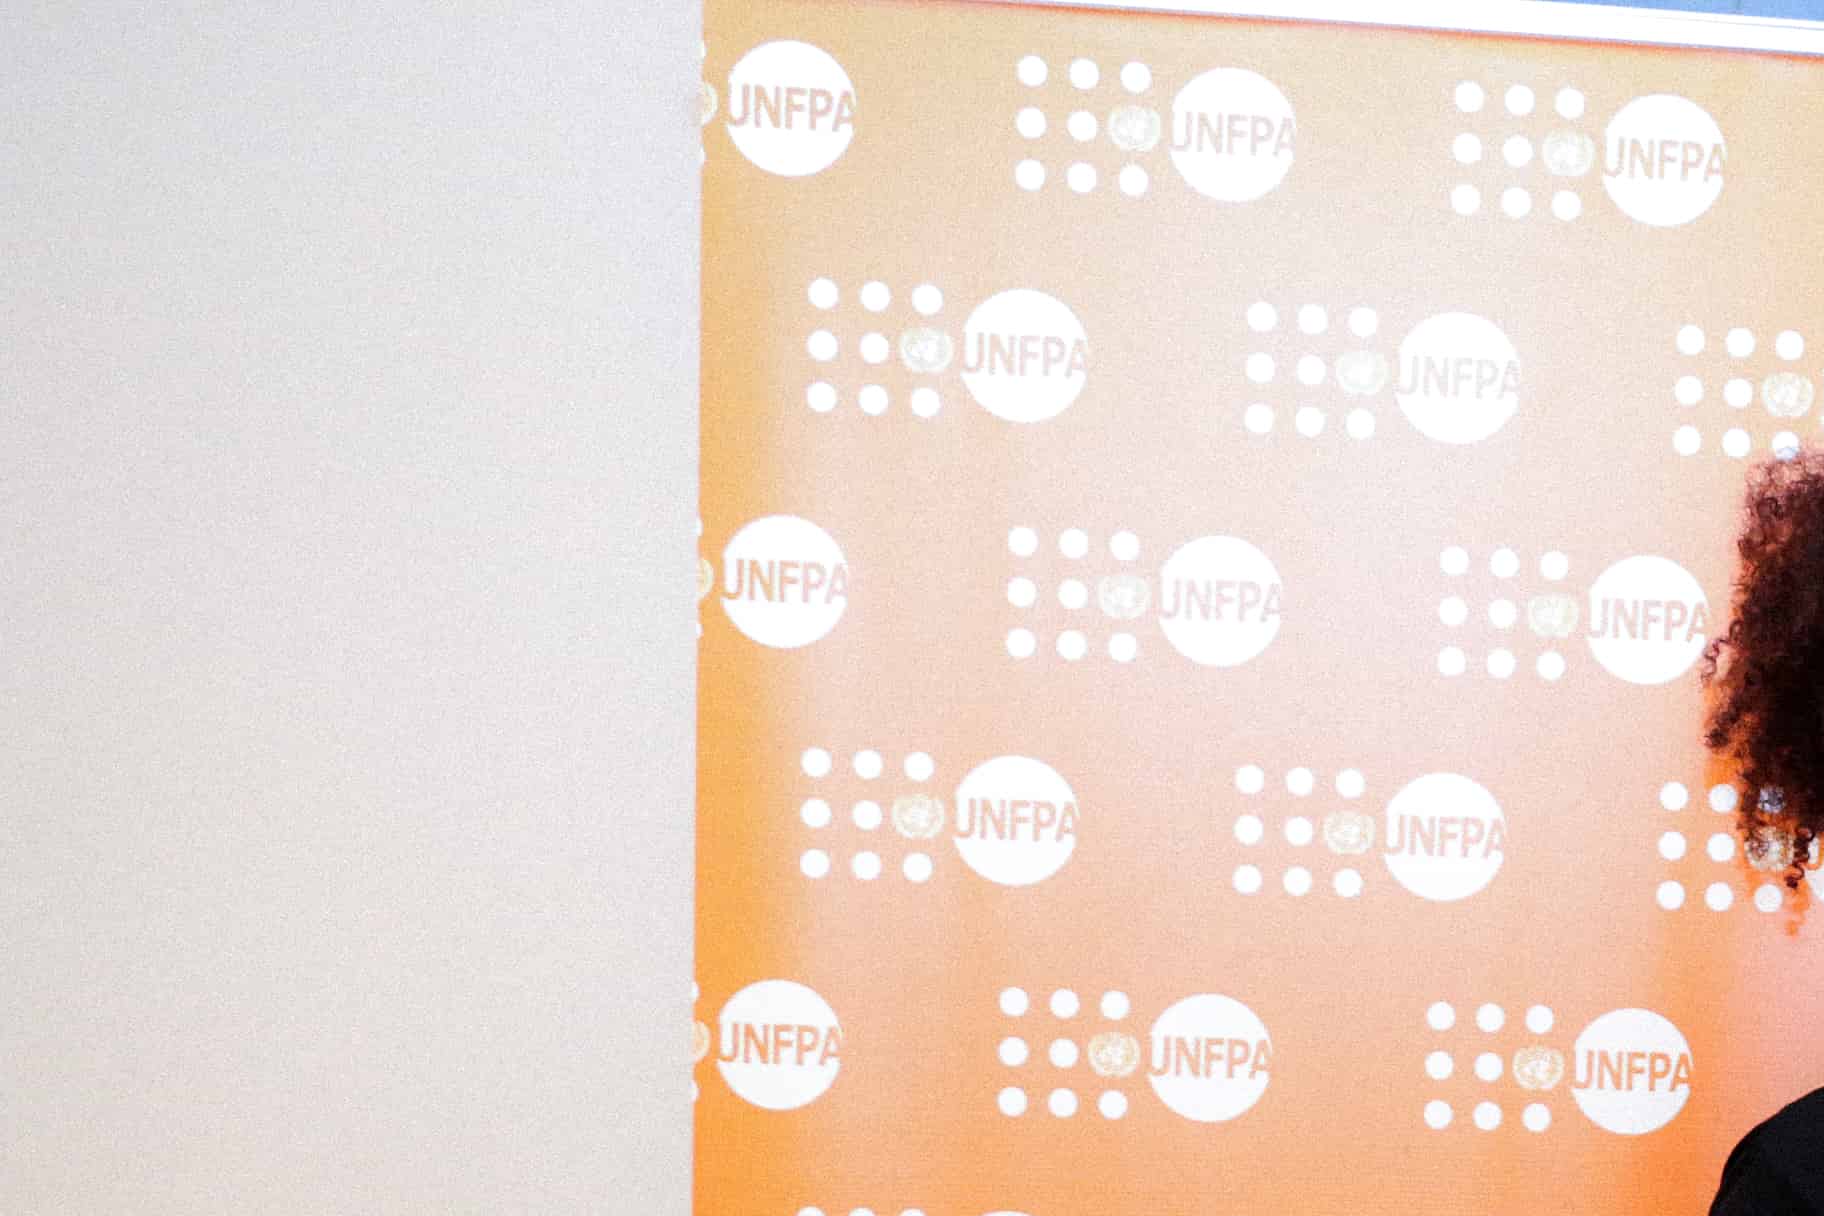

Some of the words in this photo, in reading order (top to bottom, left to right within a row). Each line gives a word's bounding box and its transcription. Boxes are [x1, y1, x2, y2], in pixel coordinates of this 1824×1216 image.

[728, 83, 857, 132] UNFPA
[1169, 110, 1297, 157] UNFPA
[1602, 137, 1726, 182] UNFPA
[961, 332, 1088, 378] UNFPA
[1398, 354, 1520, 397] UNFPA
[722, 558, 848, 603] UNFPA
[1158, 579, 1283, 622] UNFPA
[1586, 598, 1708, 643] UNFPA
[954, 797, 1079, 842] UNFPA
[1384, 813, 1505, 858] UNFPA
[717, 1022, 842, 1066] UNFPA
[1148, 1037, 1272, 1080] UNFPA
[1573, 1049, 1692, 1092] UNFPA
